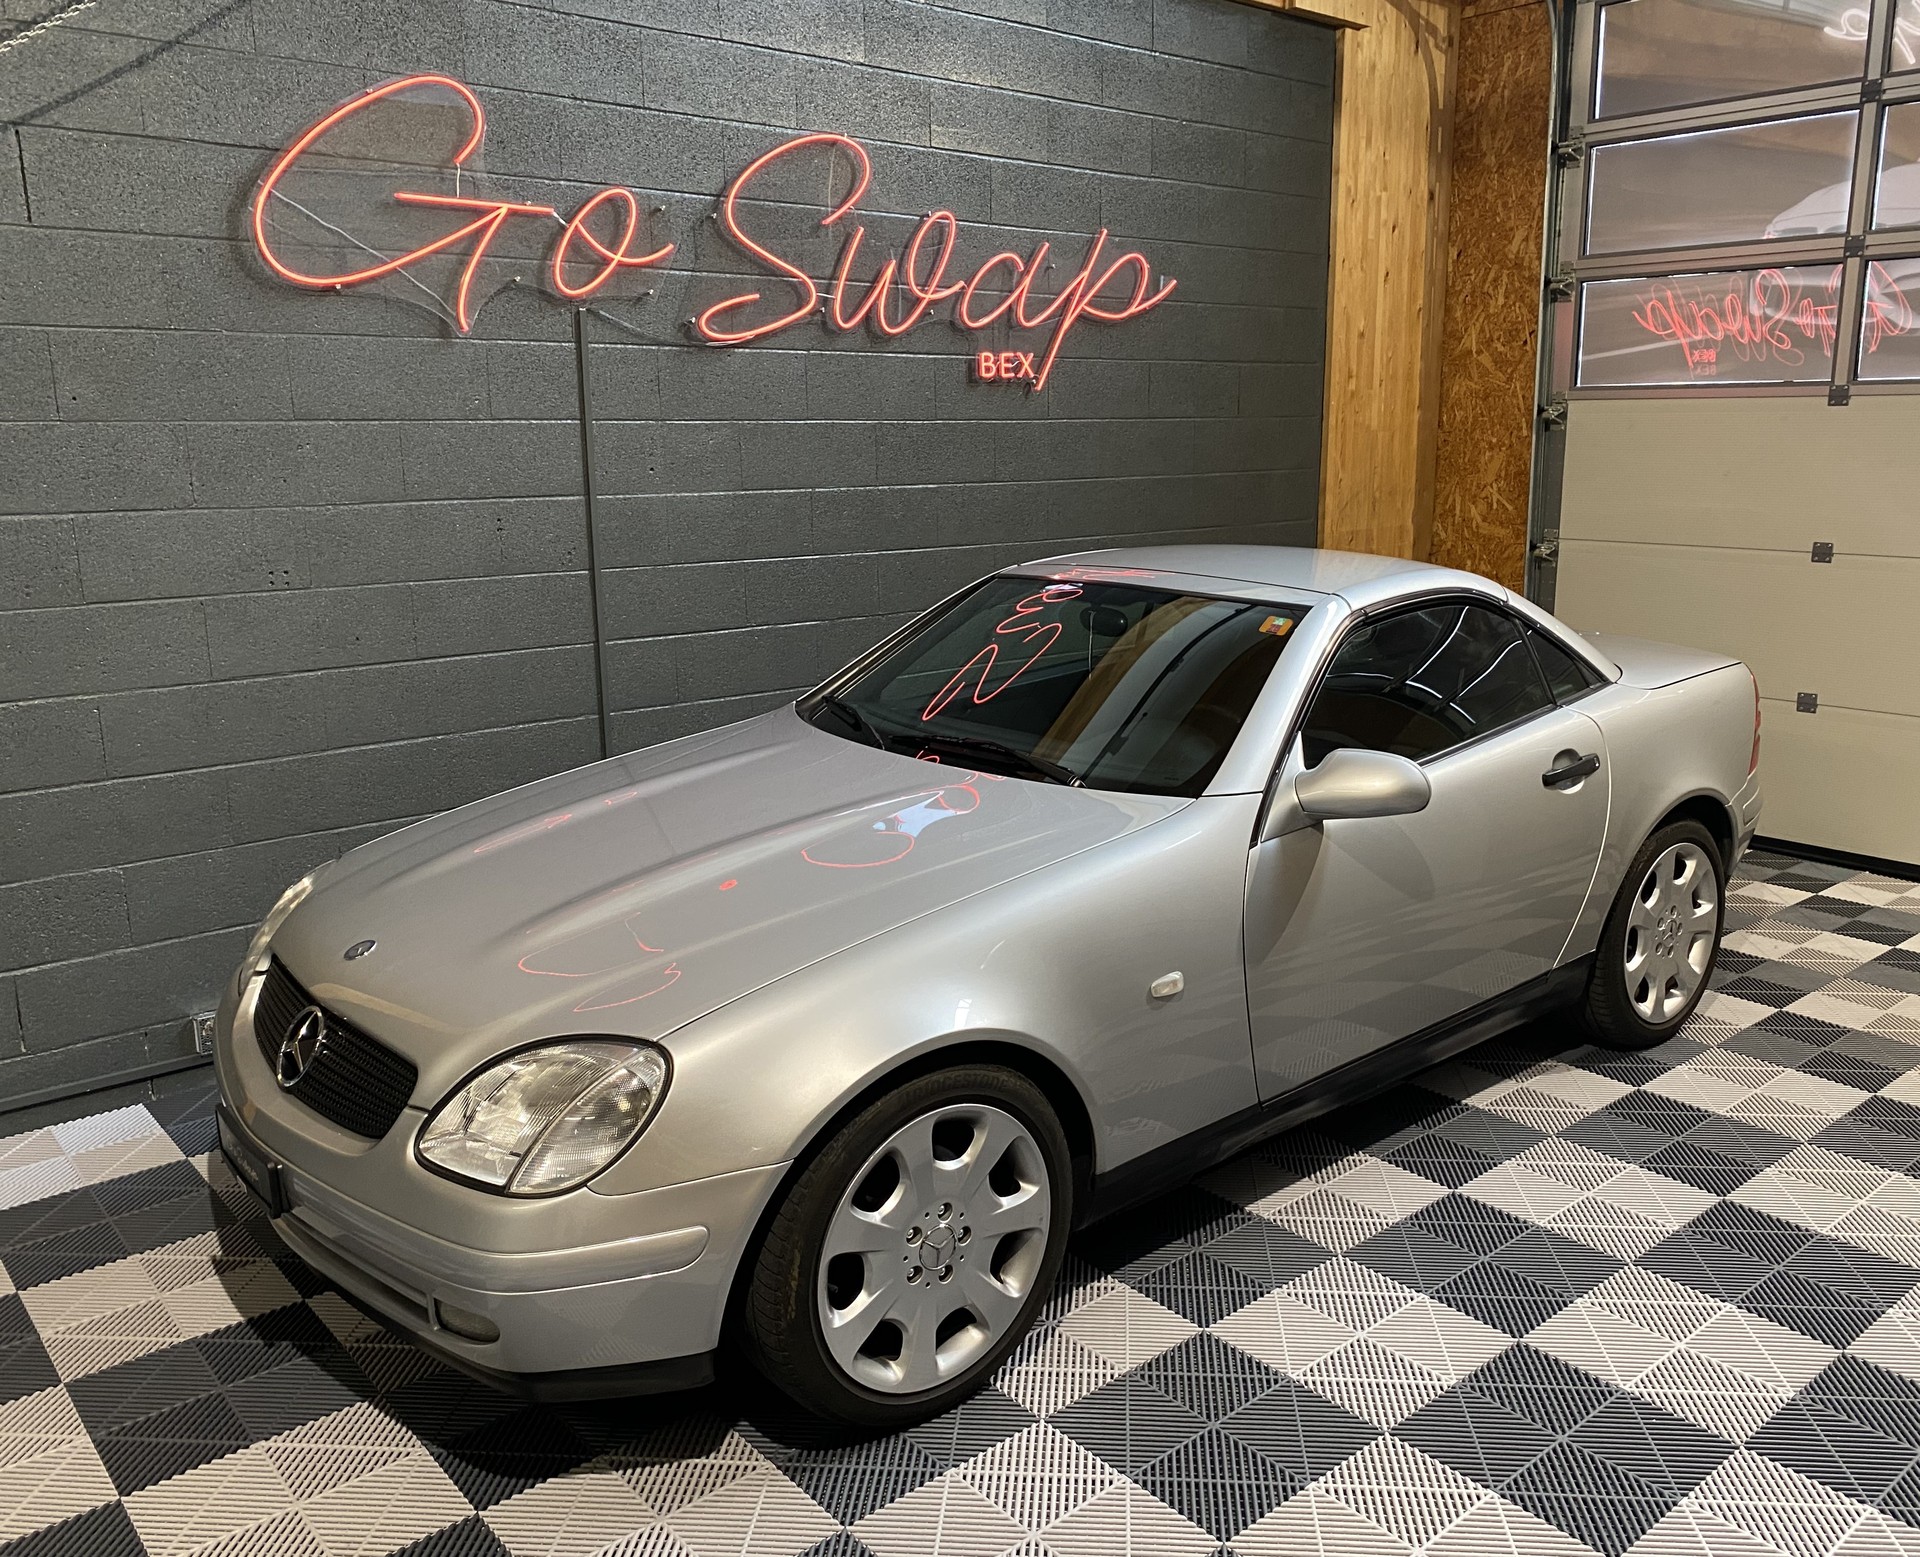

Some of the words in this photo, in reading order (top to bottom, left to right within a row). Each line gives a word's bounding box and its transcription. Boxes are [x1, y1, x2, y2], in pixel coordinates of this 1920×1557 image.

[253, 74, 674, 333] Go
[696, 133, 1177, 391] Swap
[977, 351, 1035, 379] BEX
